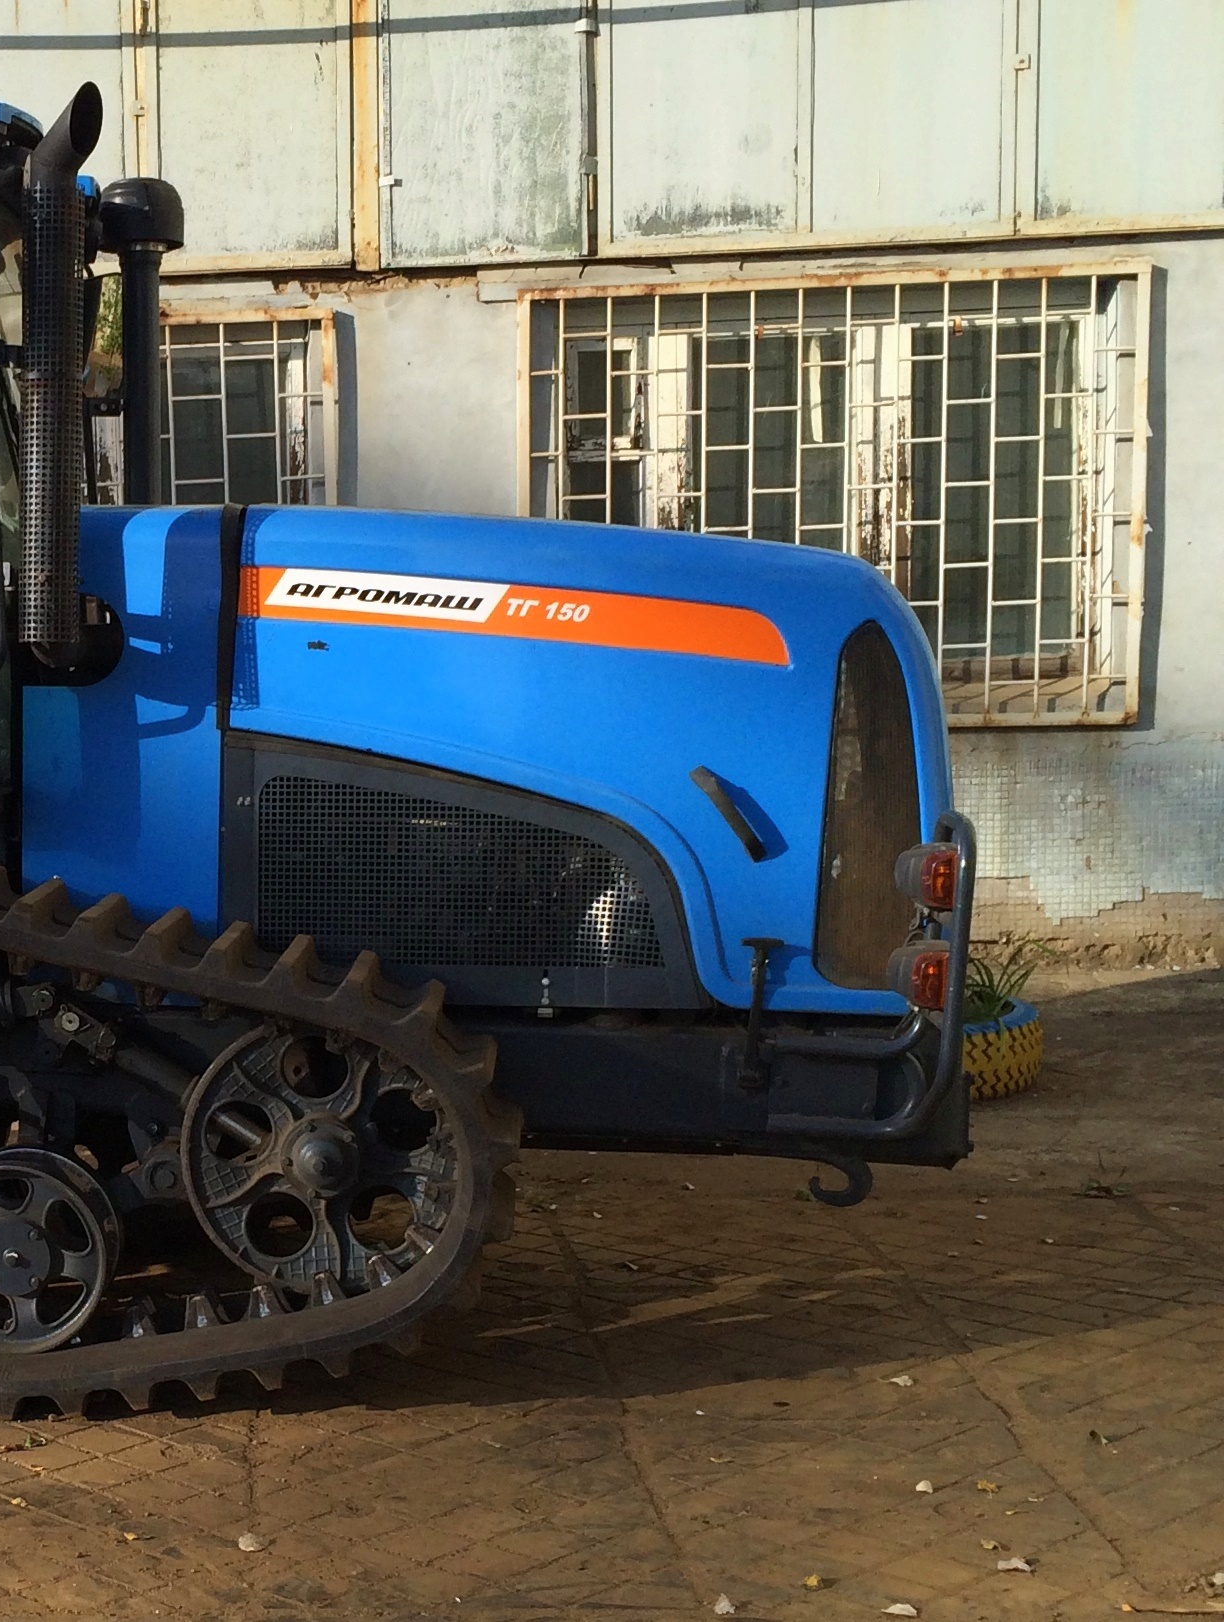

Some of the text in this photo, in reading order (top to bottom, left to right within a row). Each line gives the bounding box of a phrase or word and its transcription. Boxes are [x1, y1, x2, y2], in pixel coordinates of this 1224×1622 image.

[286, 582, 484, 611] АГРОМАШ
[505, 598, 590, 622] ТГ 150
